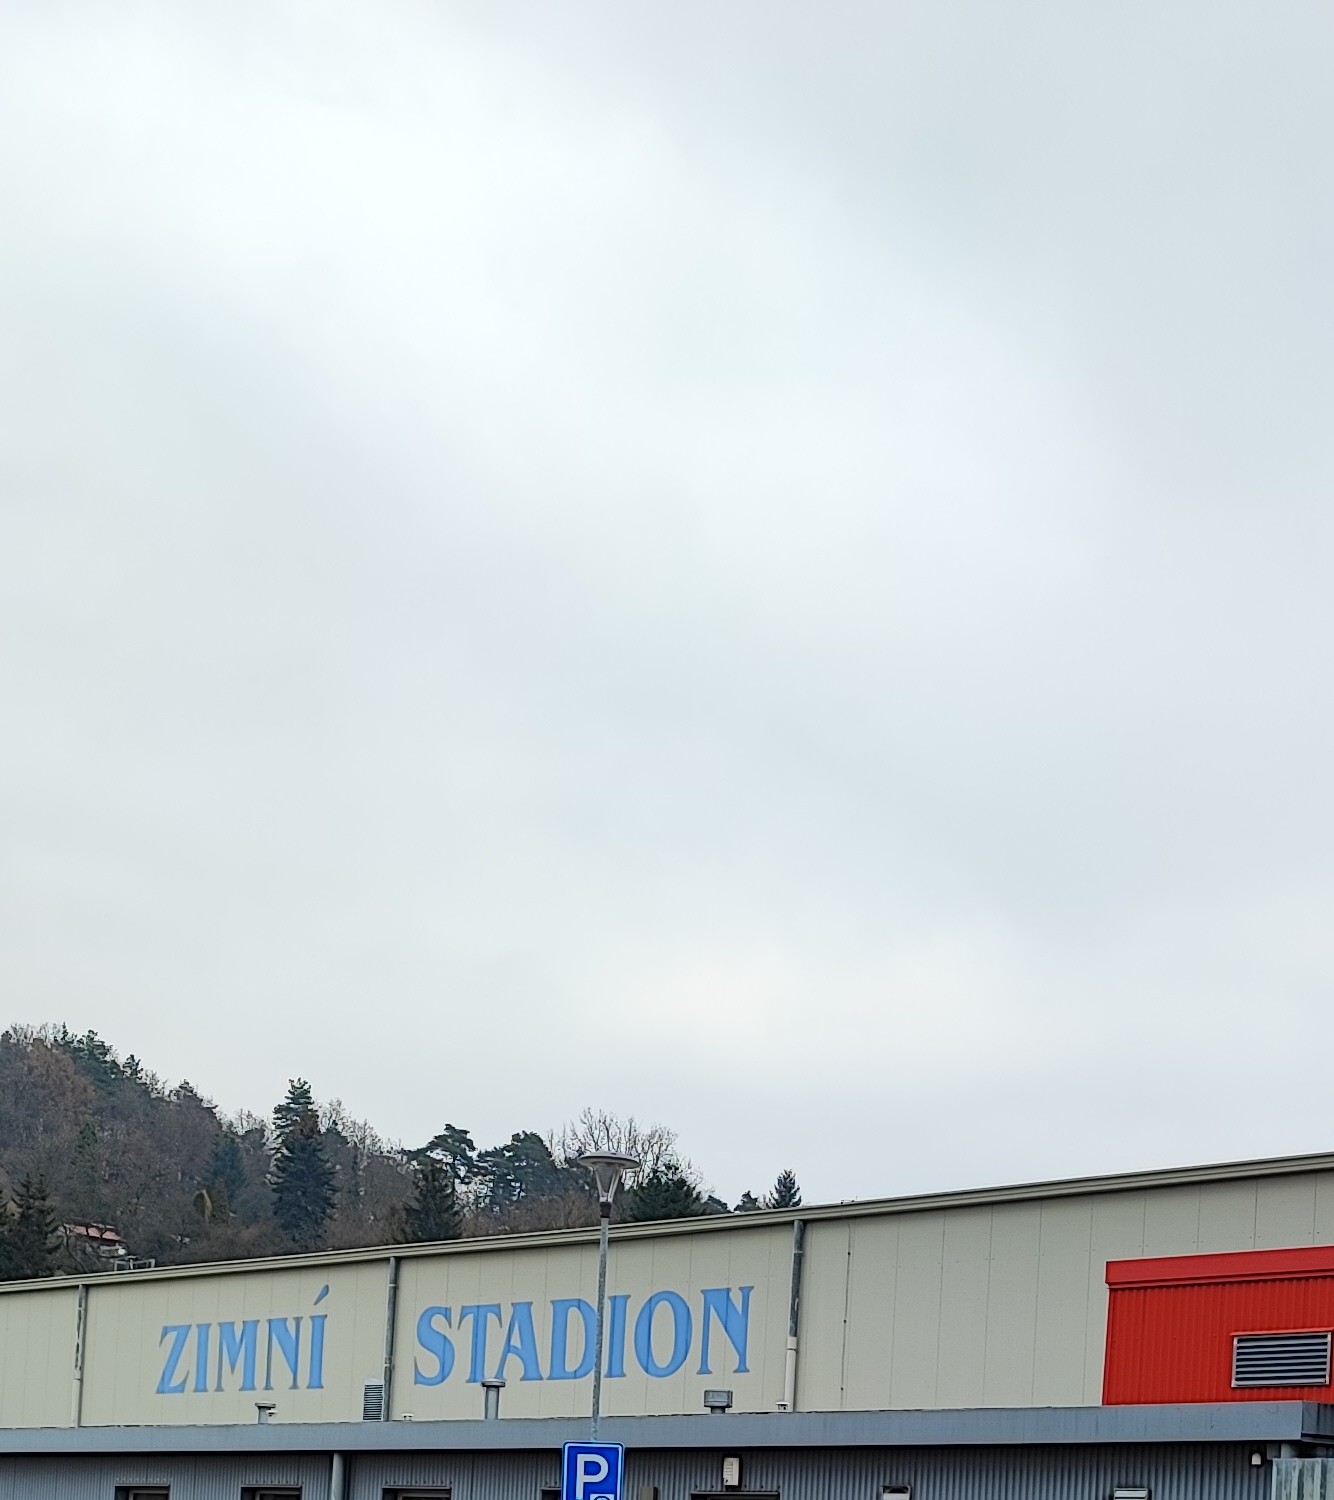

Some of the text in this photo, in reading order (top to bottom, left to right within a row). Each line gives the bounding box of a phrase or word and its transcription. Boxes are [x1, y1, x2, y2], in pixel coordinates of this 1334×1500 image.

[155, 1284, 755, 1394] ZIMNÍ STADION
[576, 1453, 609, 1500] P
